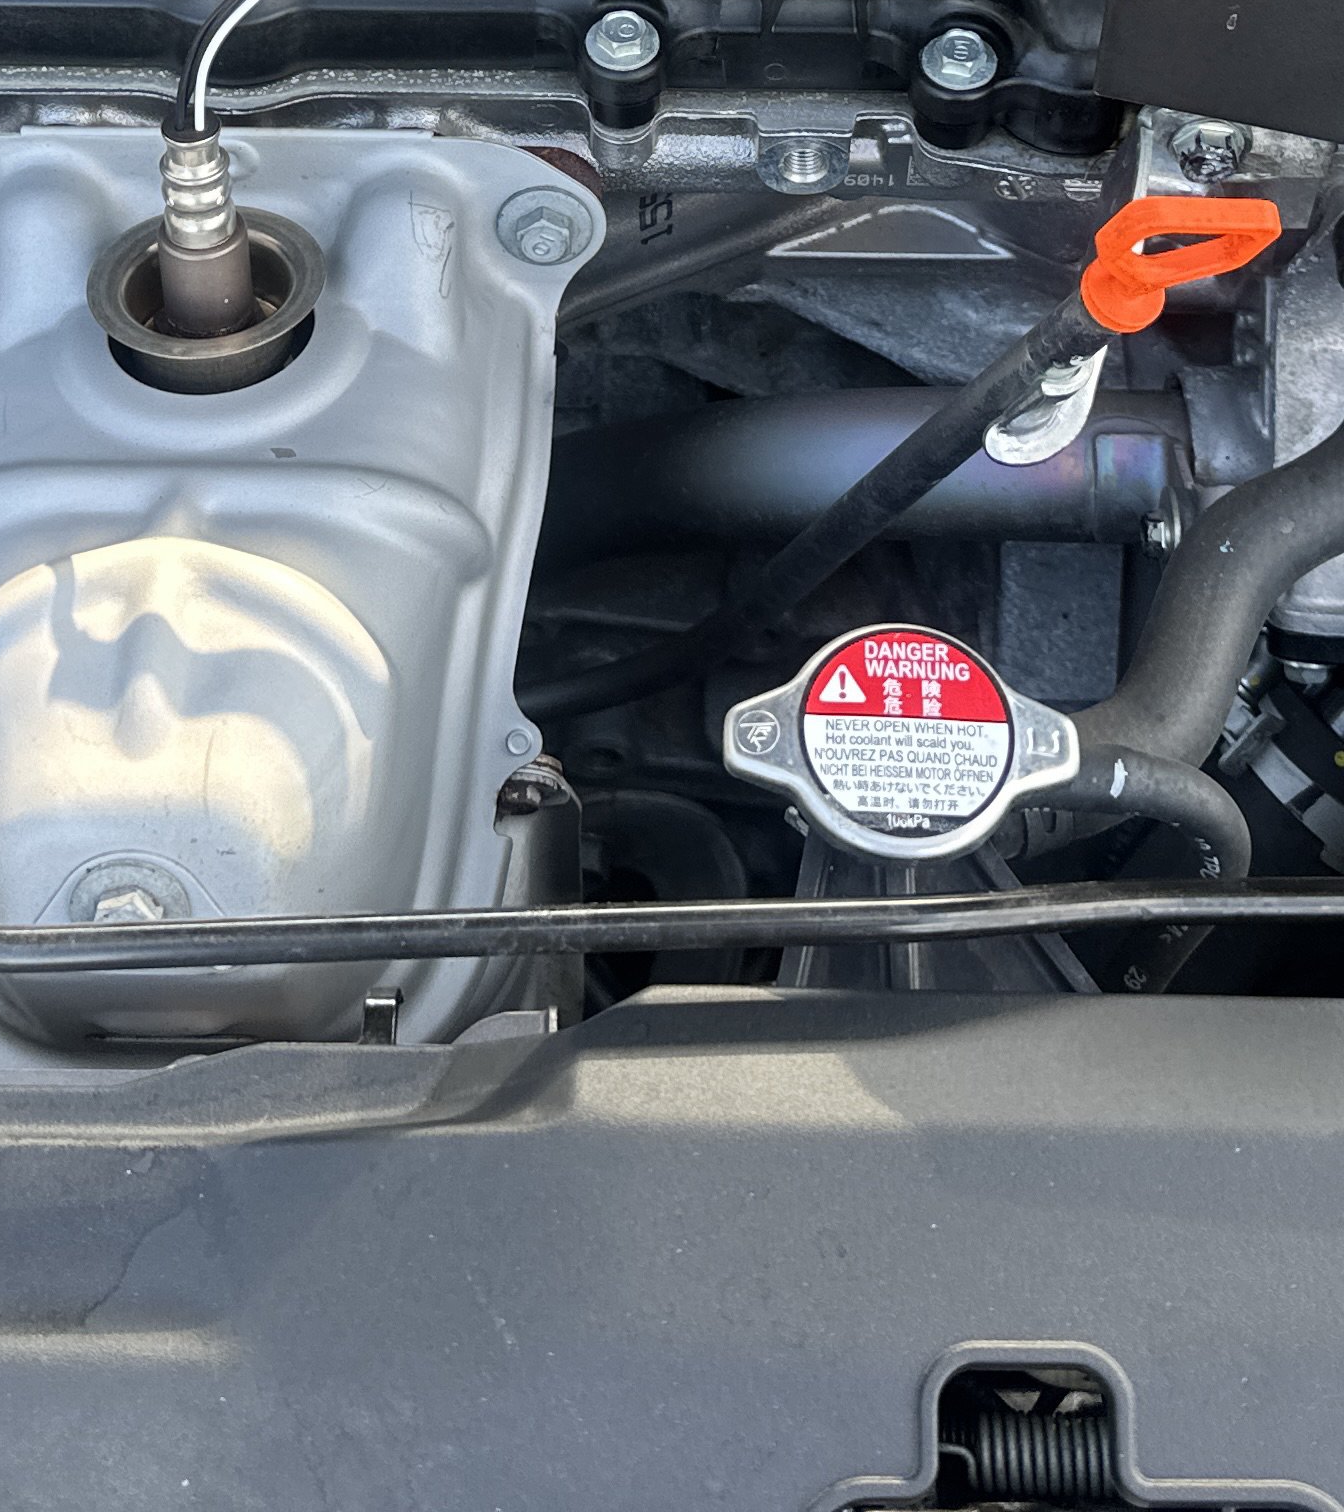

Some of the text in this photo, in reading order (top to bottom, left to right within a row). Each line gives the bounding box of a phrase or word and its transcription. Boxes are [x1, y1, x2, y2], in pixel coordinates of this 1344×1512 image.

[864, 640, 950, 662] DANGER
[864, 659, 971, 682] WARNUNG
[825, 719, 871, 732] NEVER
[873, 720, 910, 733] OPEN
[914, 721, 954, 735] WHEN
[825, 733, 975, 753] Hot coolant will scald you.
[814, 747, 998, 768] N'OUVREZ PAS QUAND CHAUD
[820, 763, 994, 783] NICHT BEI HEISSEM MOTOR ÖFFNEN
